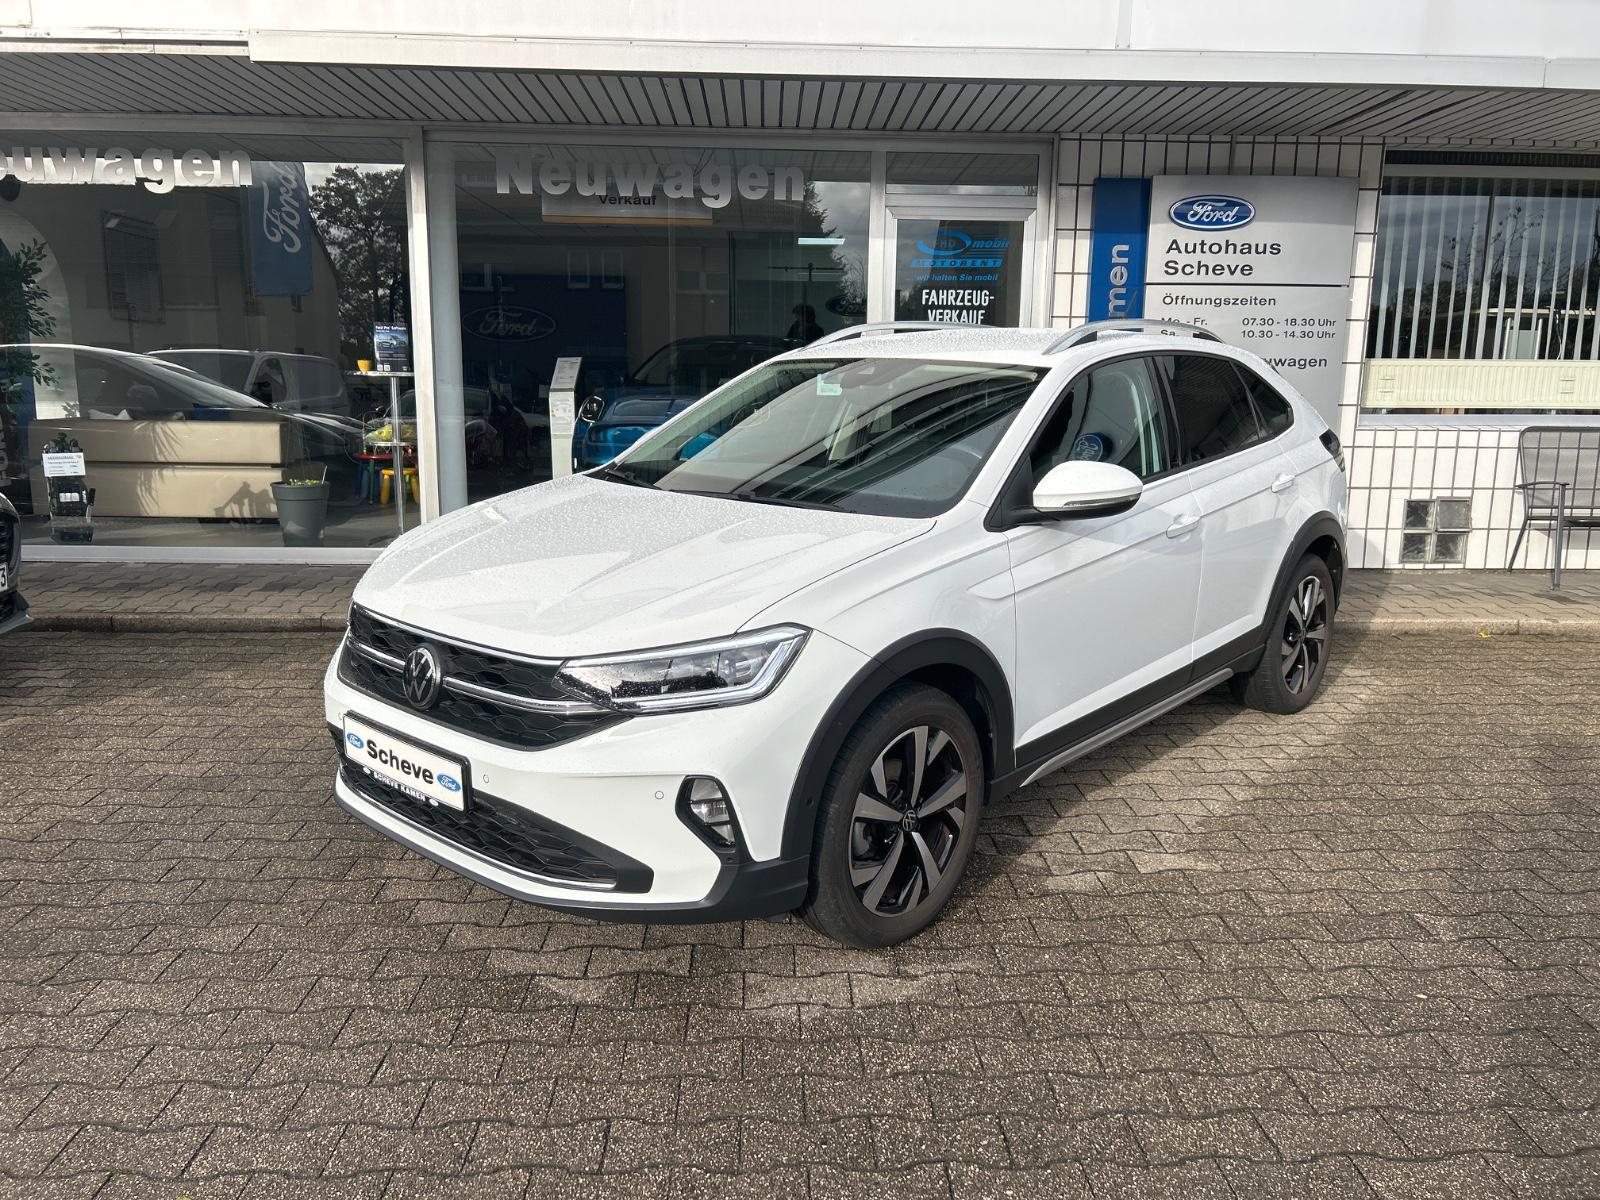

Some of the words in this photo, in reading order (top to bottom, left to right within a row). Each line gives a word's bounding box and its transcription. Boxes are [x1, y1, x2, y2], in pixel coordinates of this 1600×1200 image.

[0, 146, 252, 194] uwagen
[496, 151, 806, 208] Neuwagen
[262, 162, 301, 253] Ford
[599, 194, 656, 206] Verkauf
[971, 239, 1009, 248] mobil
[1165, 239, 1282, 255] Autohaus
[1163, 260, 1254, 276] Scheve
[932, 273, 957, 281] halten
[959, 273, 973, 281] Sie
[974, 273, 999, 281] mobil
[1108, 244, 1130, 319] men
[922, 289, 995, 306] FAHRZEUG-
[1162, 293, 1276, 308] Öffnungszeiten
[928, 309, 986, 324] VERKAUF
[1193, 317, 1208, 326] Fr.
[1242, 317, 1274, 327] 07.30
[1284, 318, 1315, 327] 18.30
[1317, 318, 1337, 327] Uhr
[1241, 330, 1273, 339] 10.30
[1283, 330, 1314, 339] 14.30
[1316, 331, 1336, 339] Uhr
[366, 739, 434, 785] Scheve
